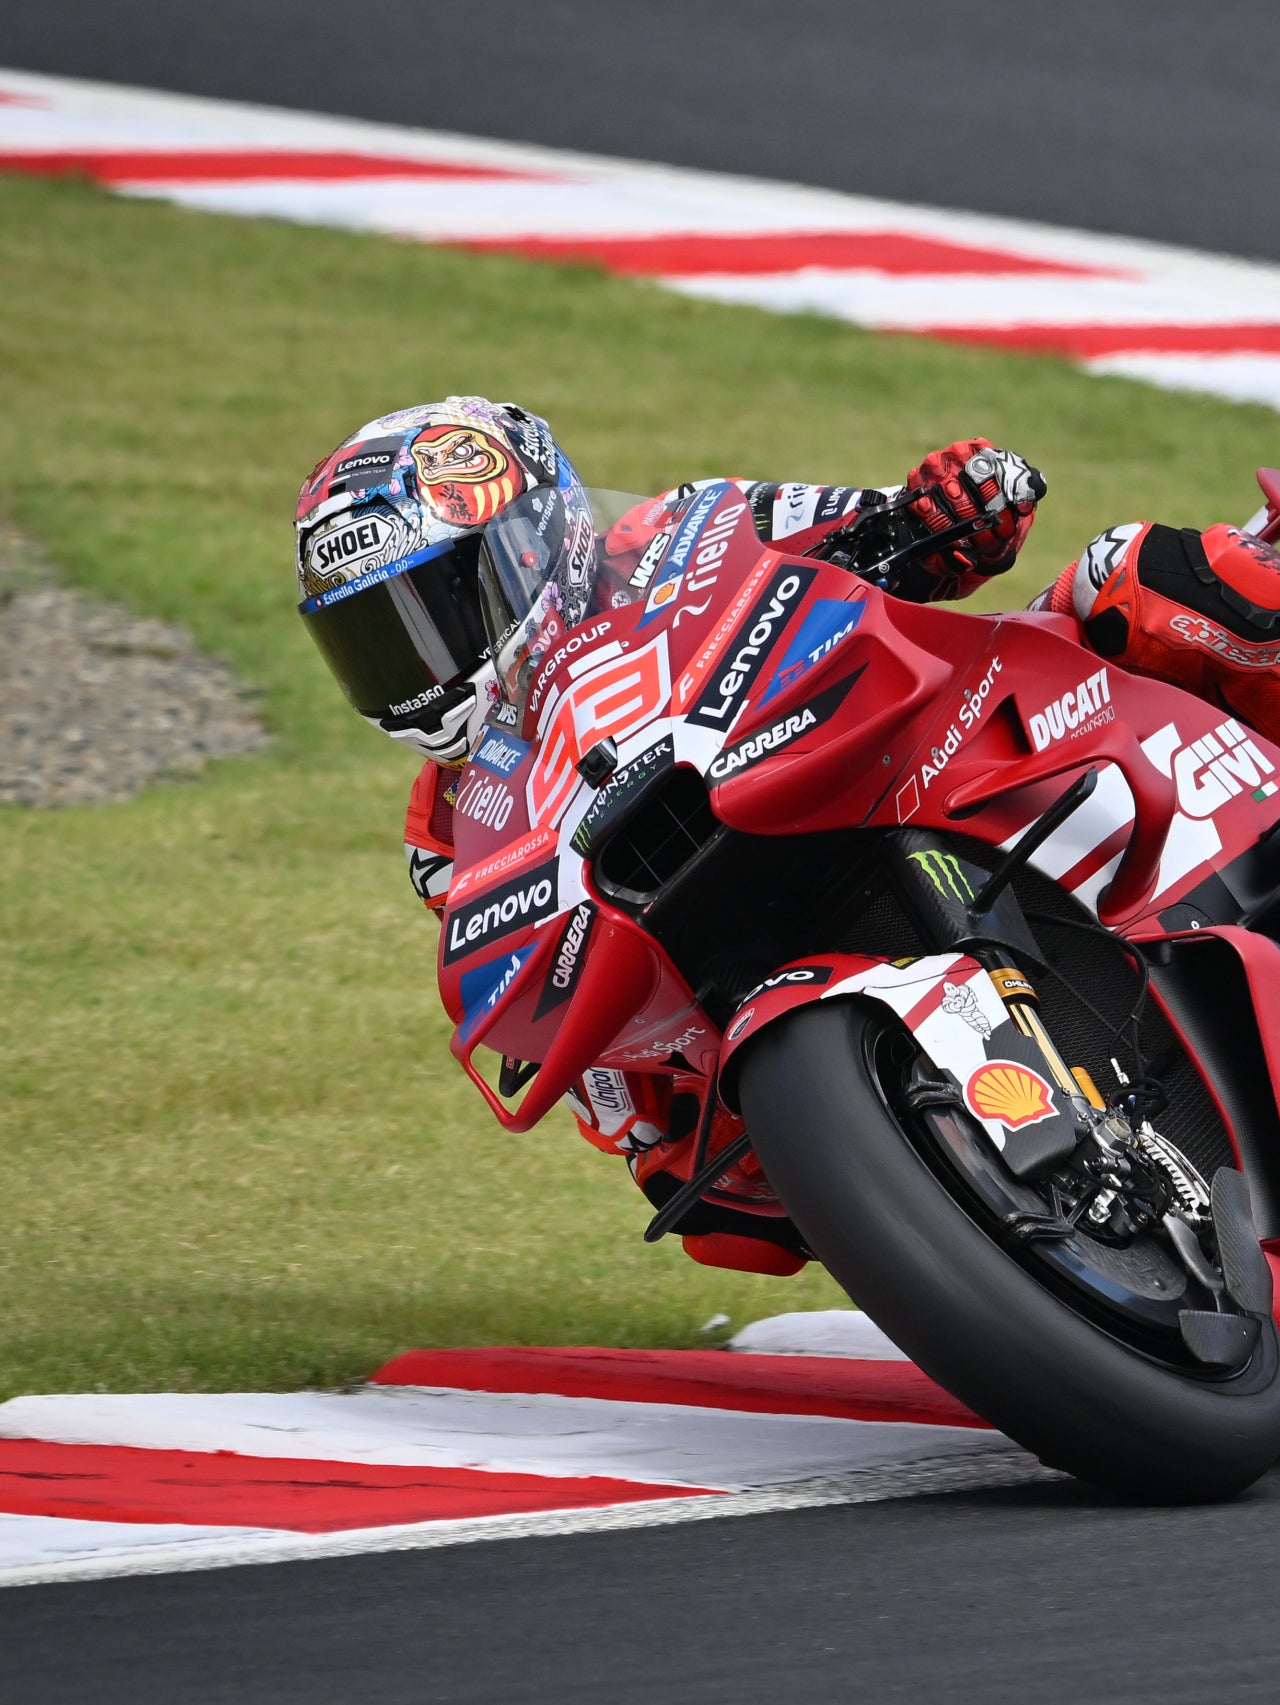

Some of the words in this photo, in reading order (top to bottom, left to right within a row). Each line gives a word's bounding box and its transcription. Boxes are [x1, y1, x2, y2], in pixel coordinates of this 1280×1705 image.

[337, 455, 390, 472] Lenovo
[534, 490, 557, 537] verisure
[672, 489, 722, 567] ADVANCE
[316, 522, 381, 569] SHOEI
[629, 533, 671, 588] WRS
[686, 503, 747, 592] riello
[323, 585, 354, 605] Estrella
[354, 568, 389, 592] Galicia
[696, 558, 772, 669] FRECCIAROSSA
[530, 621, 612, 713] VARGROUP
[699, 575, 801, 718] Lenovo
[808, 620, 854, 663] TIM
[389, 685, 444, 716] Insta360
[921, 725, 963, 789] Audi
[959, 655, 1003, 730] Sport
[1029, 667, 1111, 752] DUCATI
[477, 738, 521, 771] ADVANCE
[709, 708, 817, 779] CARRERA
[462, 776, 514, 831] riello
[587, 741, 672, 824] MONSTER
[599, 763, 657, 820] ENERGY
[475, 832, 549, 881] FRECCIAROSSA
[450, 879, 552, 952] Lenovo
[552, 904, 591, 988] CARRERA
[488, 954, 521, 1007] TIM
[659, 1026, 707, 1059] Sport
